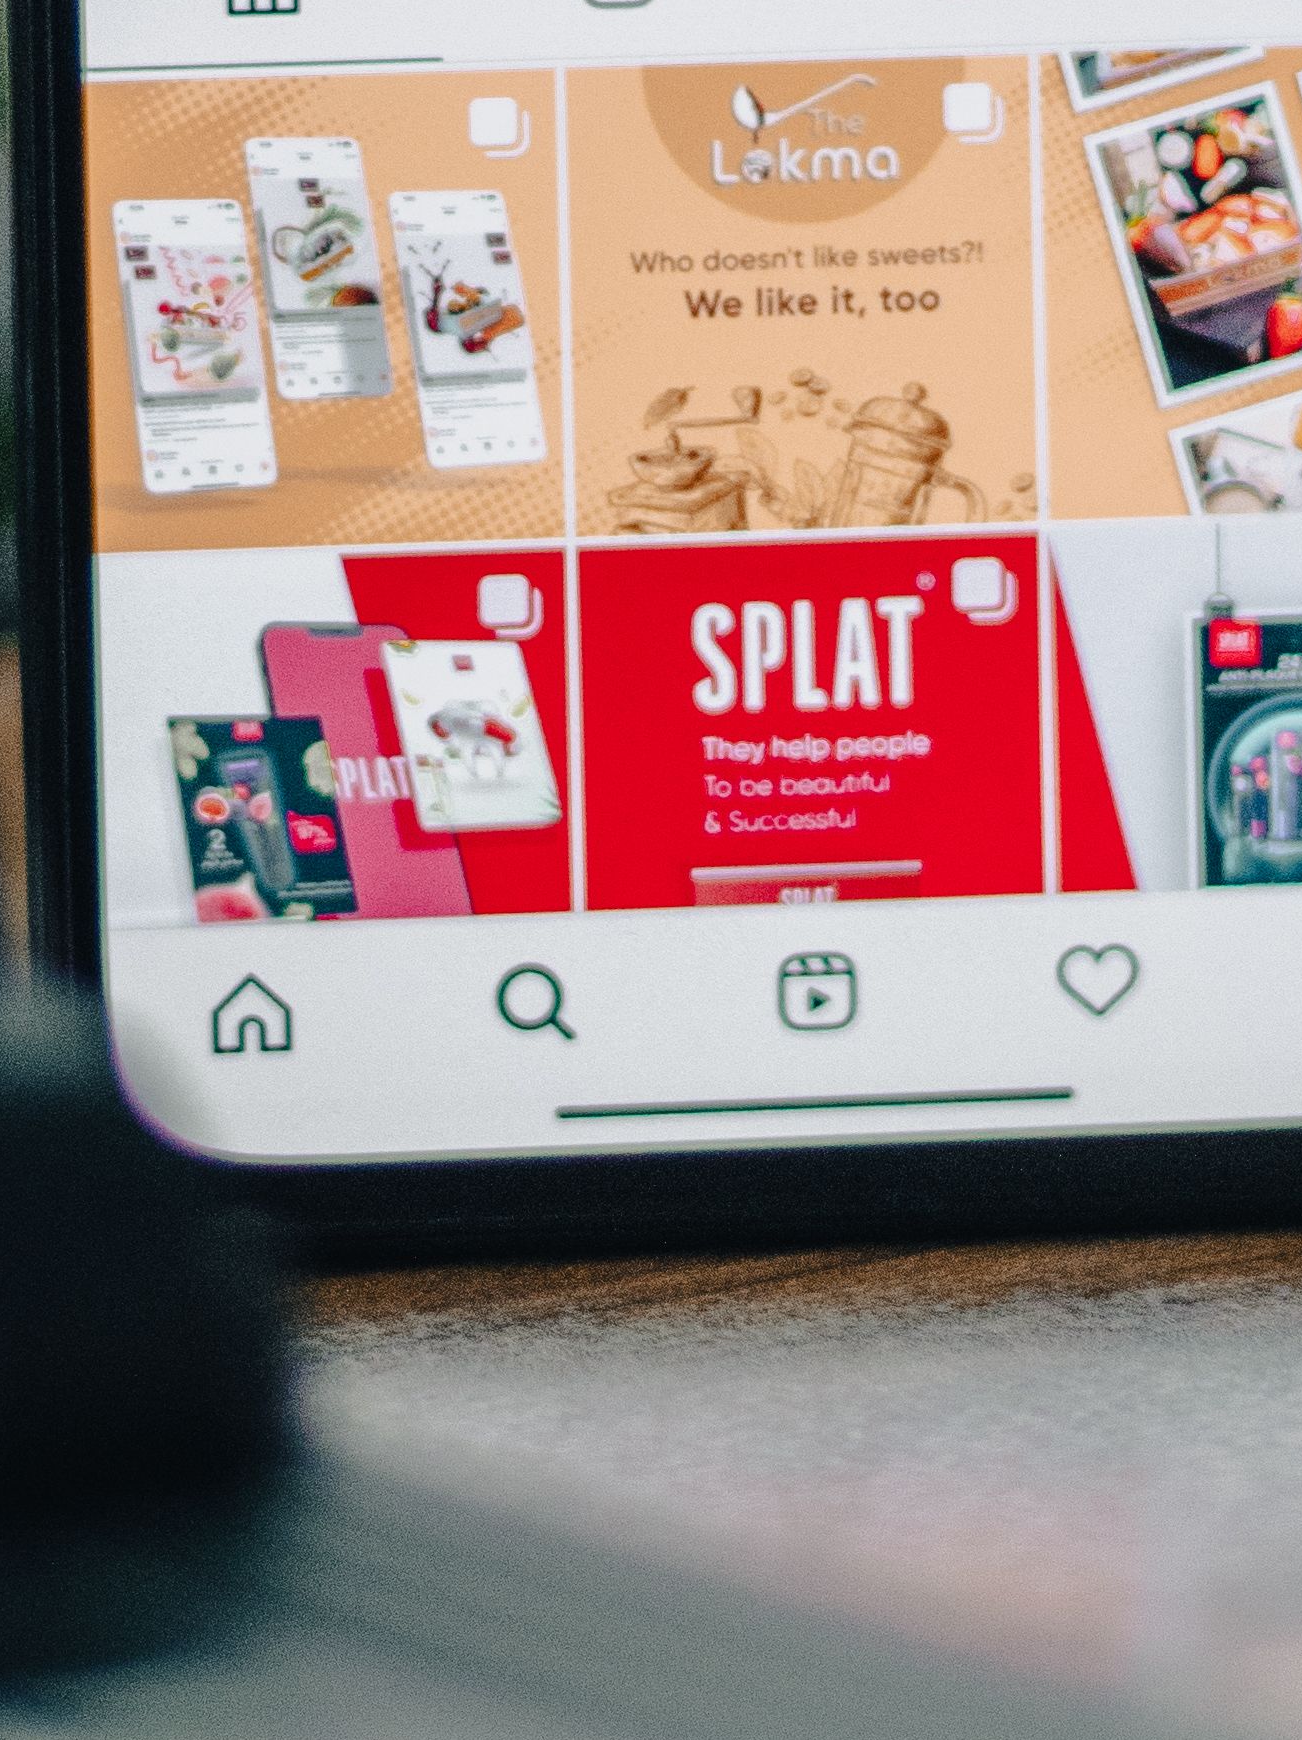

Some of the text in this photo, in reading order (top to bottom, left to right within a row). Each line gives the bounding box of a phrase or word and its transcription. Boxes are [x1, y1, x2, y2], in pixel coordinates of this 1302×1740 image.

[629, 239, 984, 275] Who doesn't like sweets?!
[684, 285, 940, 319] We like it, too
[691, 594, 925, 714] SPLAT
[702, 730, 931, 764] They help people
[333, 756, 412, 799] PLAT
[704, 771, 890, 798] To be beautiful
[704, 808, 856, 834] & Successful
